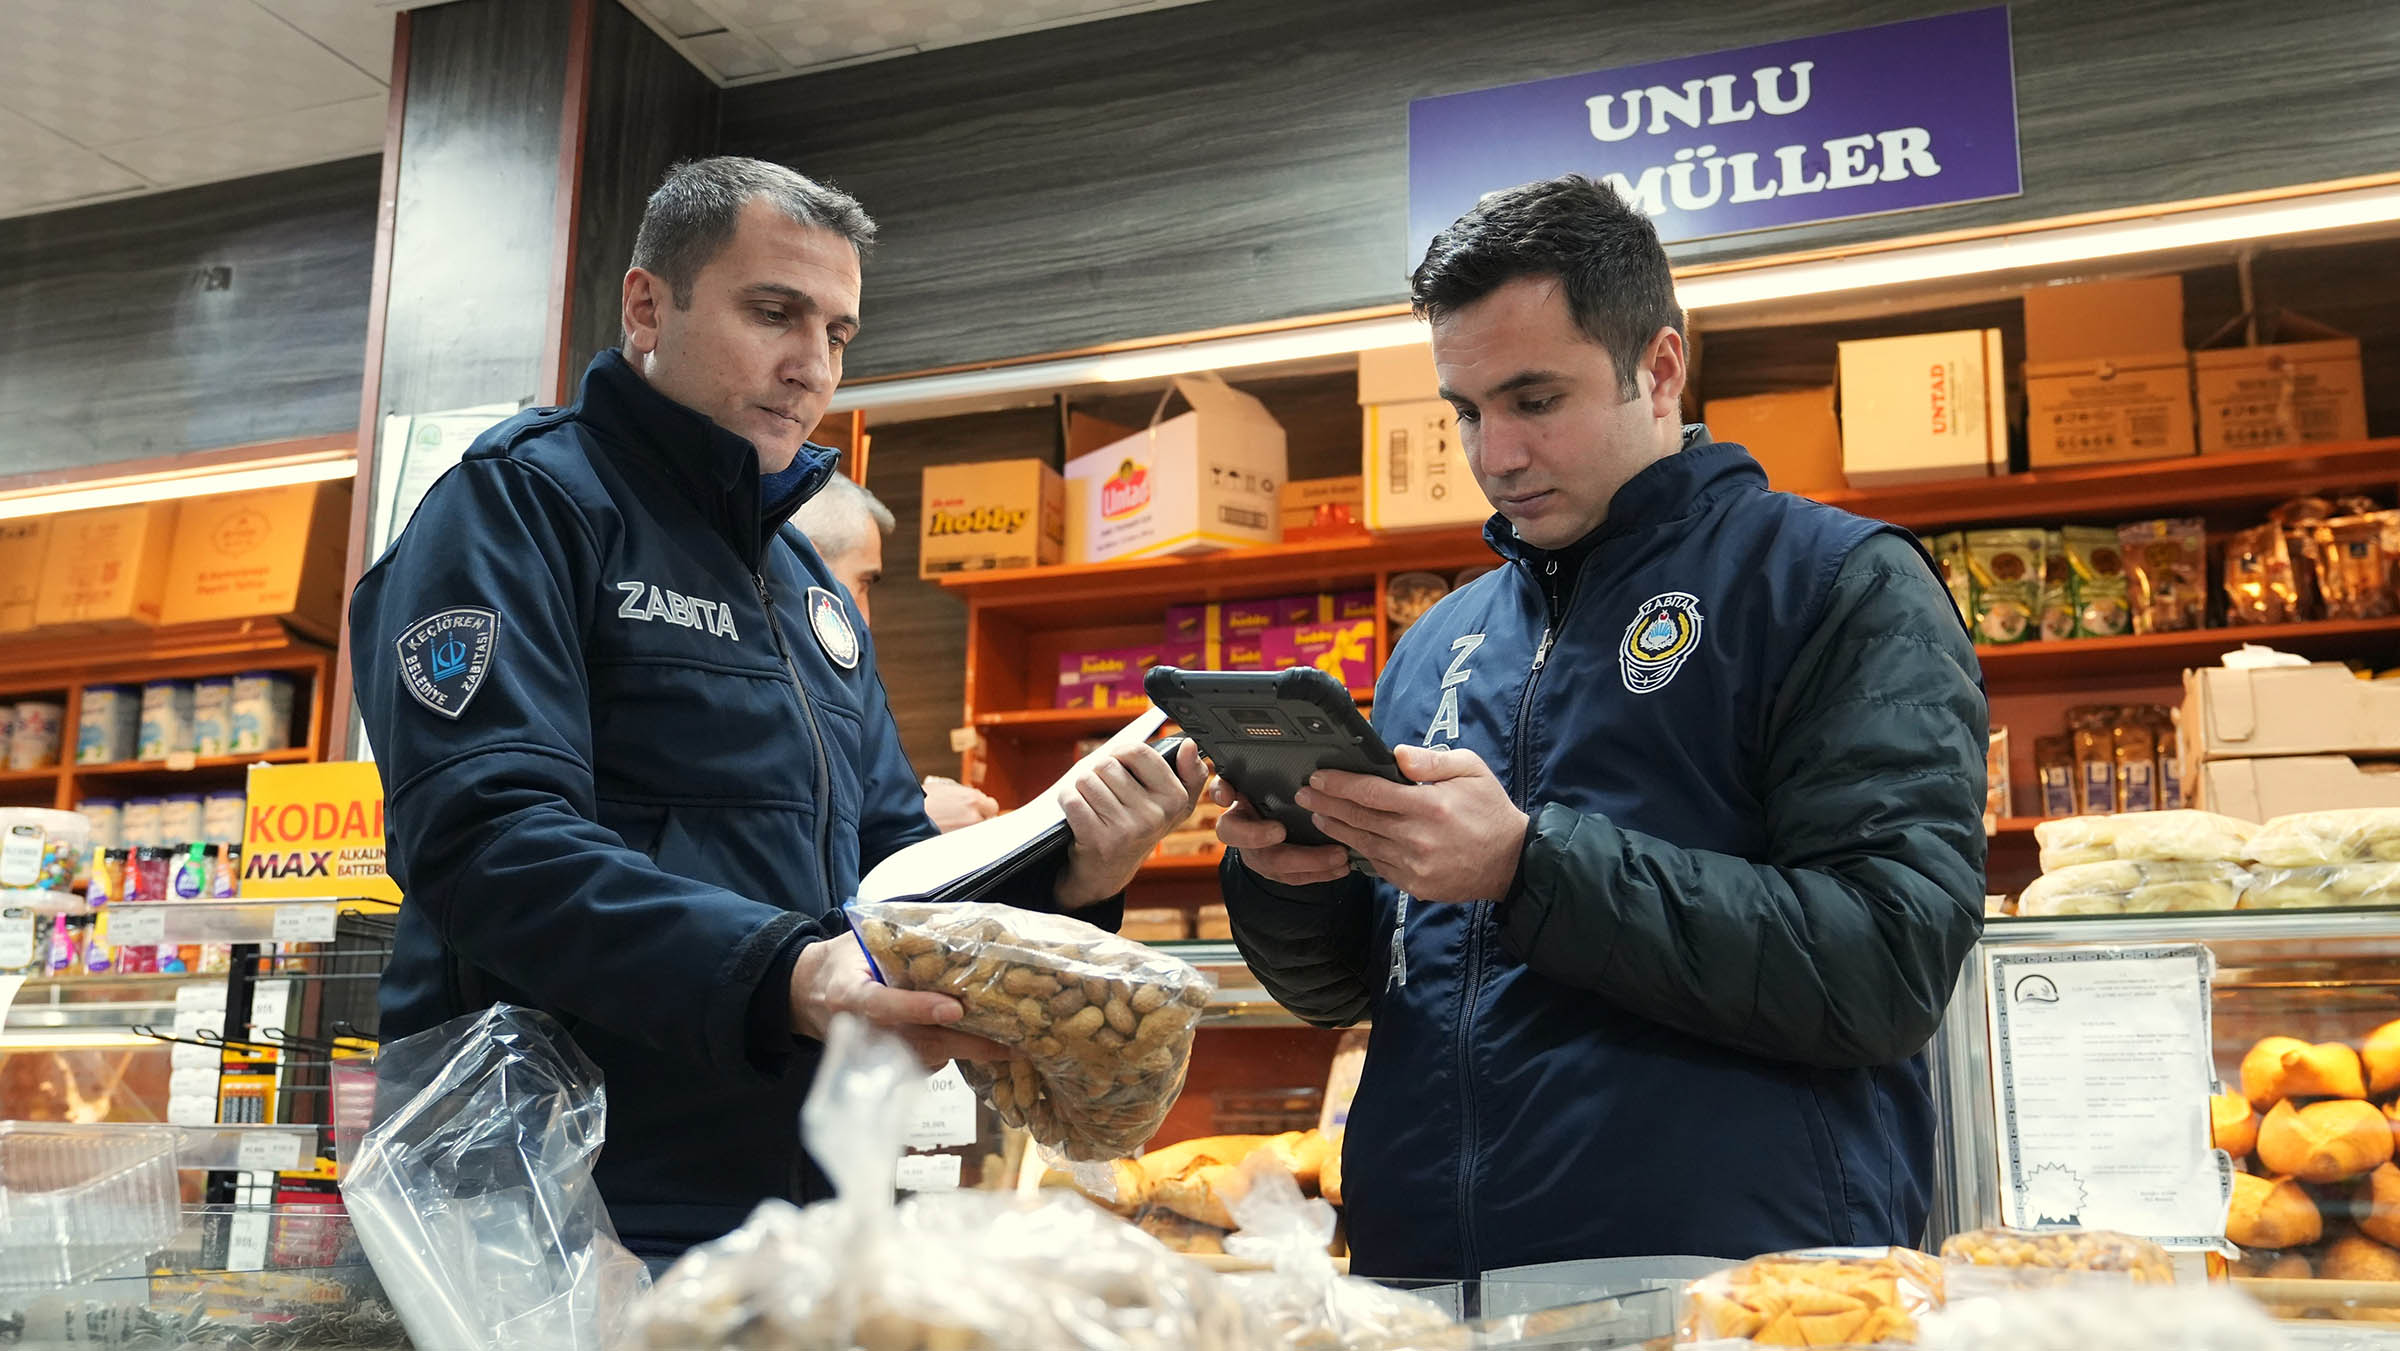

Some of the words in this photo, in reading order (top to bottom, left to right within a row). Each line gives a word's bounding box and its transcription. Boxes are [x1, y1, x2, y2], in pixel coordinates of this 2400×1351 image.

[1585, 61, 1815, 142] UNLU
[1480, 126, 1942, 218] MÜLLER
[1930, 364, 1948, 435] UNTAD
[928, 506, 1031, 537] hobby
[617, 581, 740, 641] ZABITA
[1643, 595, 1691, 616] ZABITA
[407, 615, 486, 652] KEÇİÖREN
[405, 655, 449, 706] BELEDİYE
[461, 631, 490, 692] ZABITASI
[244, 850, 334, 880] MAX
